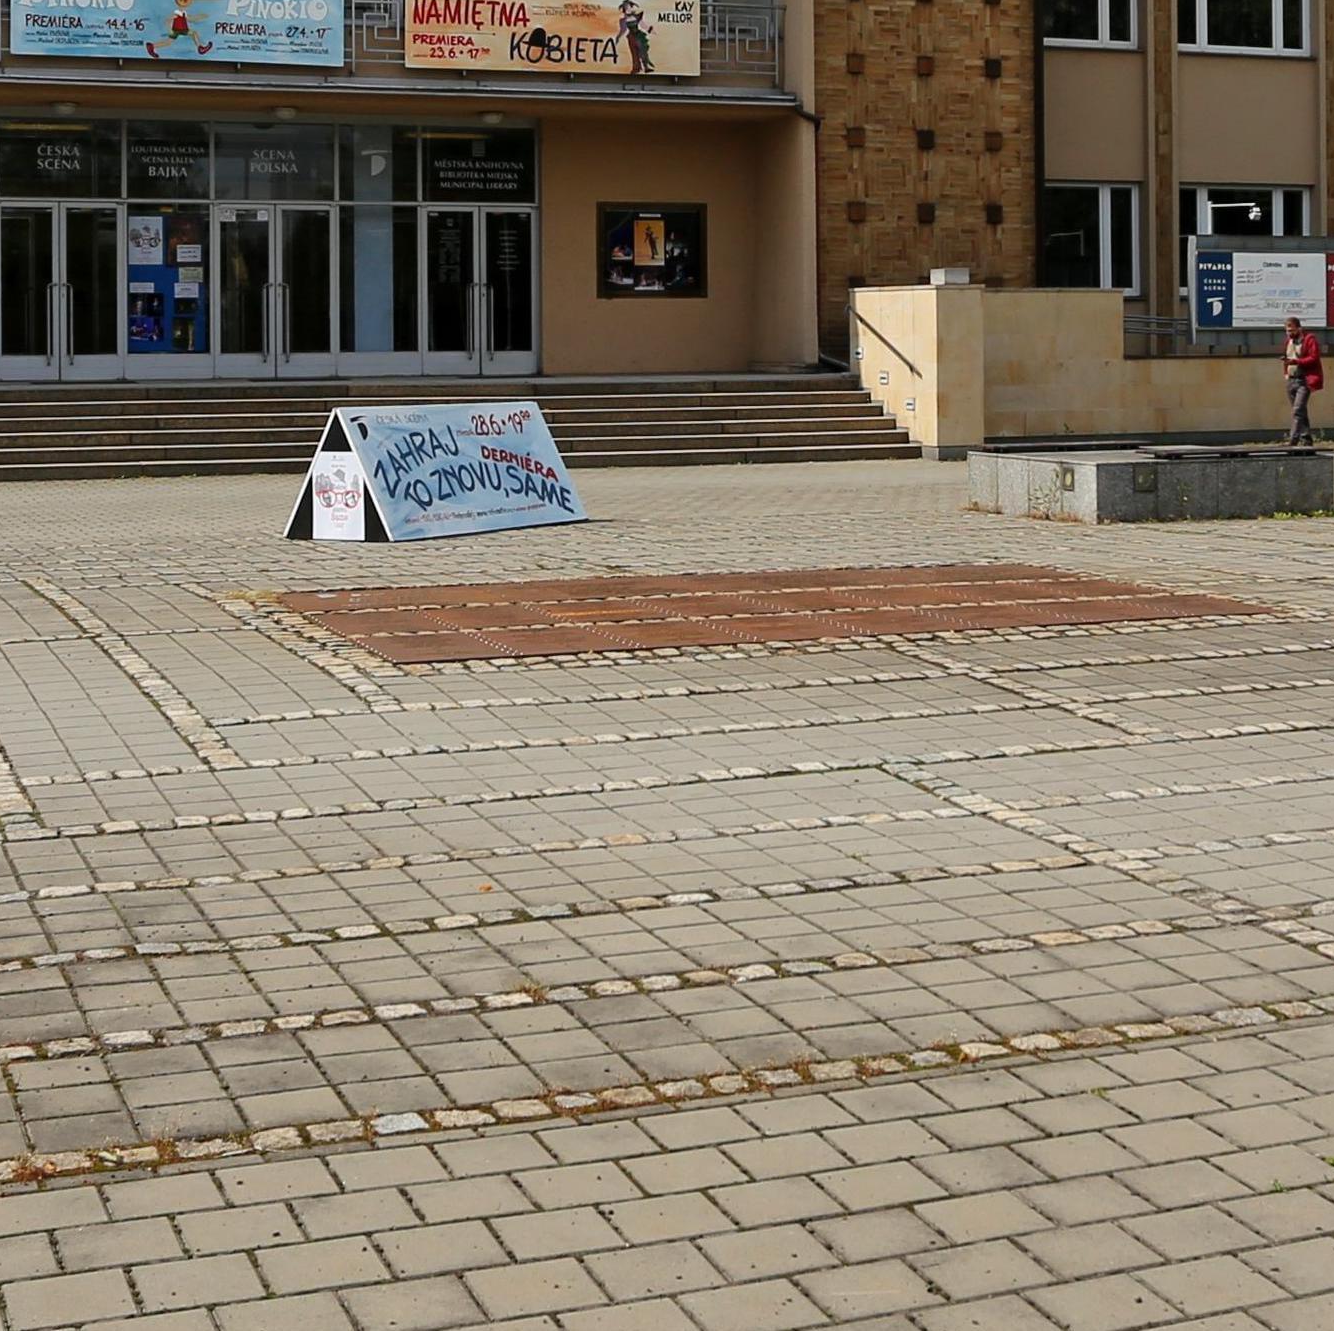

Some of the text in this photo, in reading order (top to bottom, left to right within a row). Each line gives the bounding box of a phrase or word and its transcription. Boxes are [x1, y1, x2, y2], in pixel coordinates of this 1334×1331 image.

[675, 1, 695, 13] KAY
[25, 14, 84, 29] PREMIÉRA
[413, 34, 475, 47] PREMIERA
[252, 149, 296, 161] SCENA
[148, 166, 188, 178] BAJKA
[250, 161, 299, 174] POLSKA
[373, 424, 459, 499] ZAHRAJ
[404, 479, 434, 511] TO
